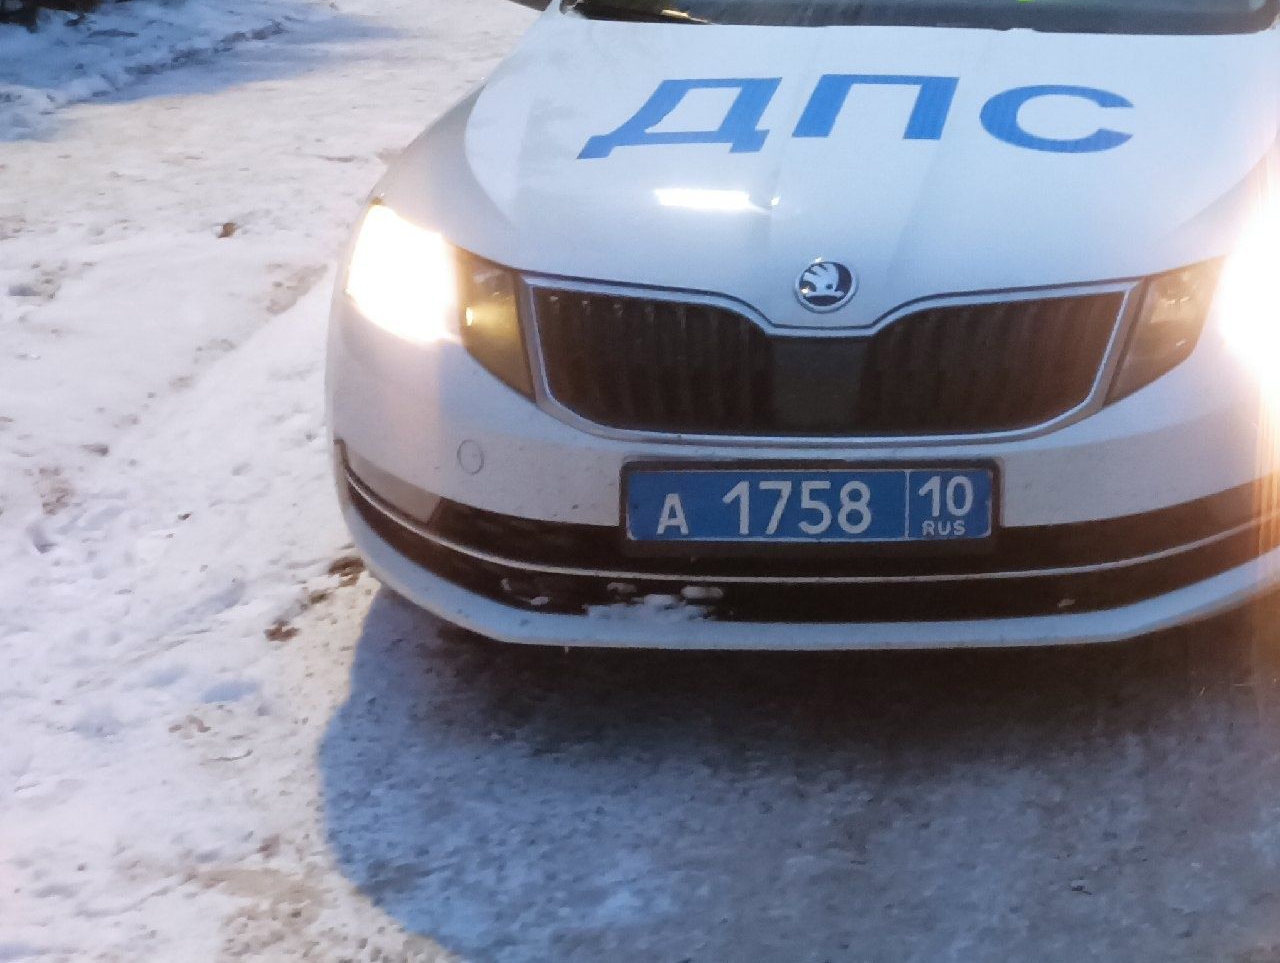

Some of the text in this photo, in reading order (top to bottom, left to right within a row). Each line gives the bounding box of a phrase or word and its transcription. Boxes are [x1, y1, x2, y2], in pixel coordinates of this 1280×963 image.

[576, 74, 1134, 159] ДПС
[722, 480, 872, 535] 1758
[919, 476, 974, 517] 10
[922, 520, 966, 536] RUS
